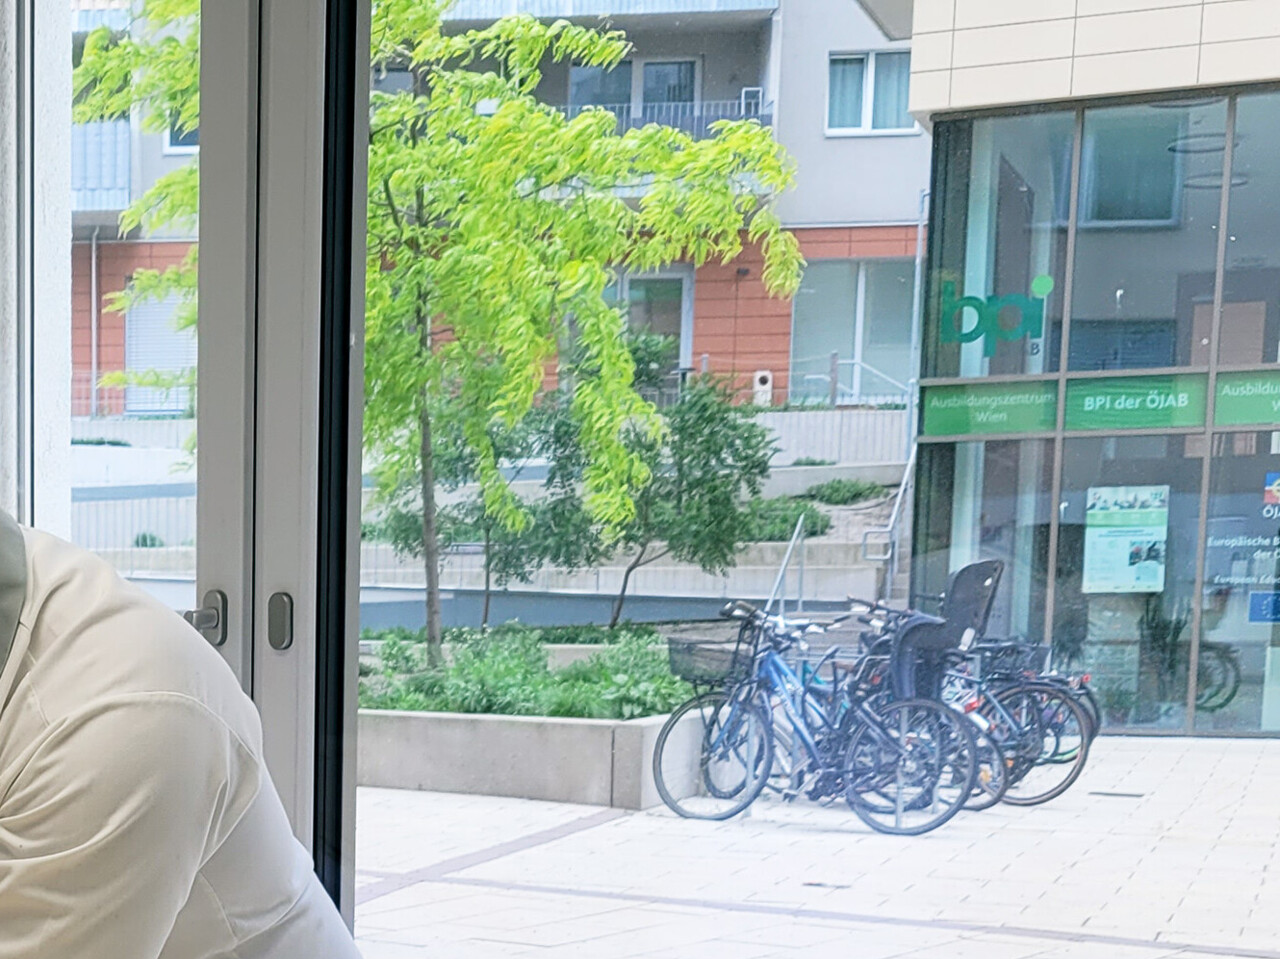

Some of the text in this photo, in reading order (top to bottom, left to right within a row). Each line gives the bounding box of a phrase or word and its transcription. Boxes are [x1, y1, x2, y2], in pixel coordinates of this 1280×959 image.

[940, 274, 1054, 358] bpi
[1221, 380, 1280, 396] Ausbildu
[1084, 389, 1189, 411] BPI der ÖJAB
[976, 411, 1007, 422] Wien
[1263, 503, 1280, 519] ÖJ
